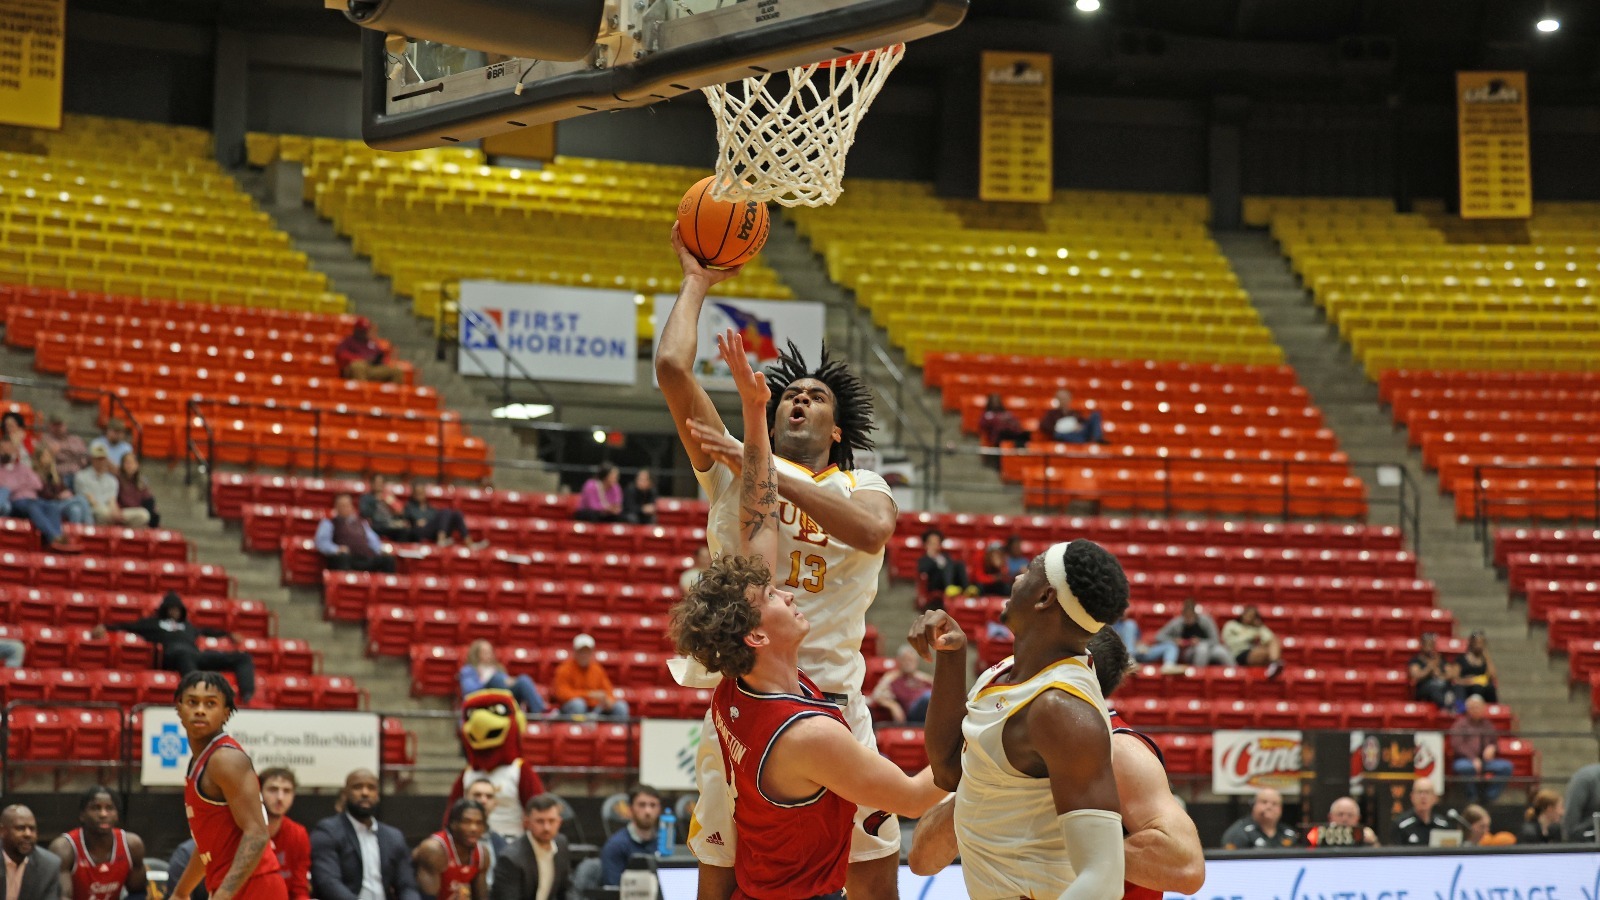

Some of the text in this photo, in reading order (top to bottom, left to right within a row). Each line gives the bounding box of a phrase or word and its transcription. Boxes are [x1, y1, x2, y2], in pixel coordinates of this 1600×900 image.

[492, 67, 504, 79] BPI
[508, 309, 579, 332] FIRST
[508, 334, 626, 358] HORIZON
[785, 550, 826, 593] 13
[706, 838, 725, 846] adidas
[1317, 825, 1353, 845] POSS
